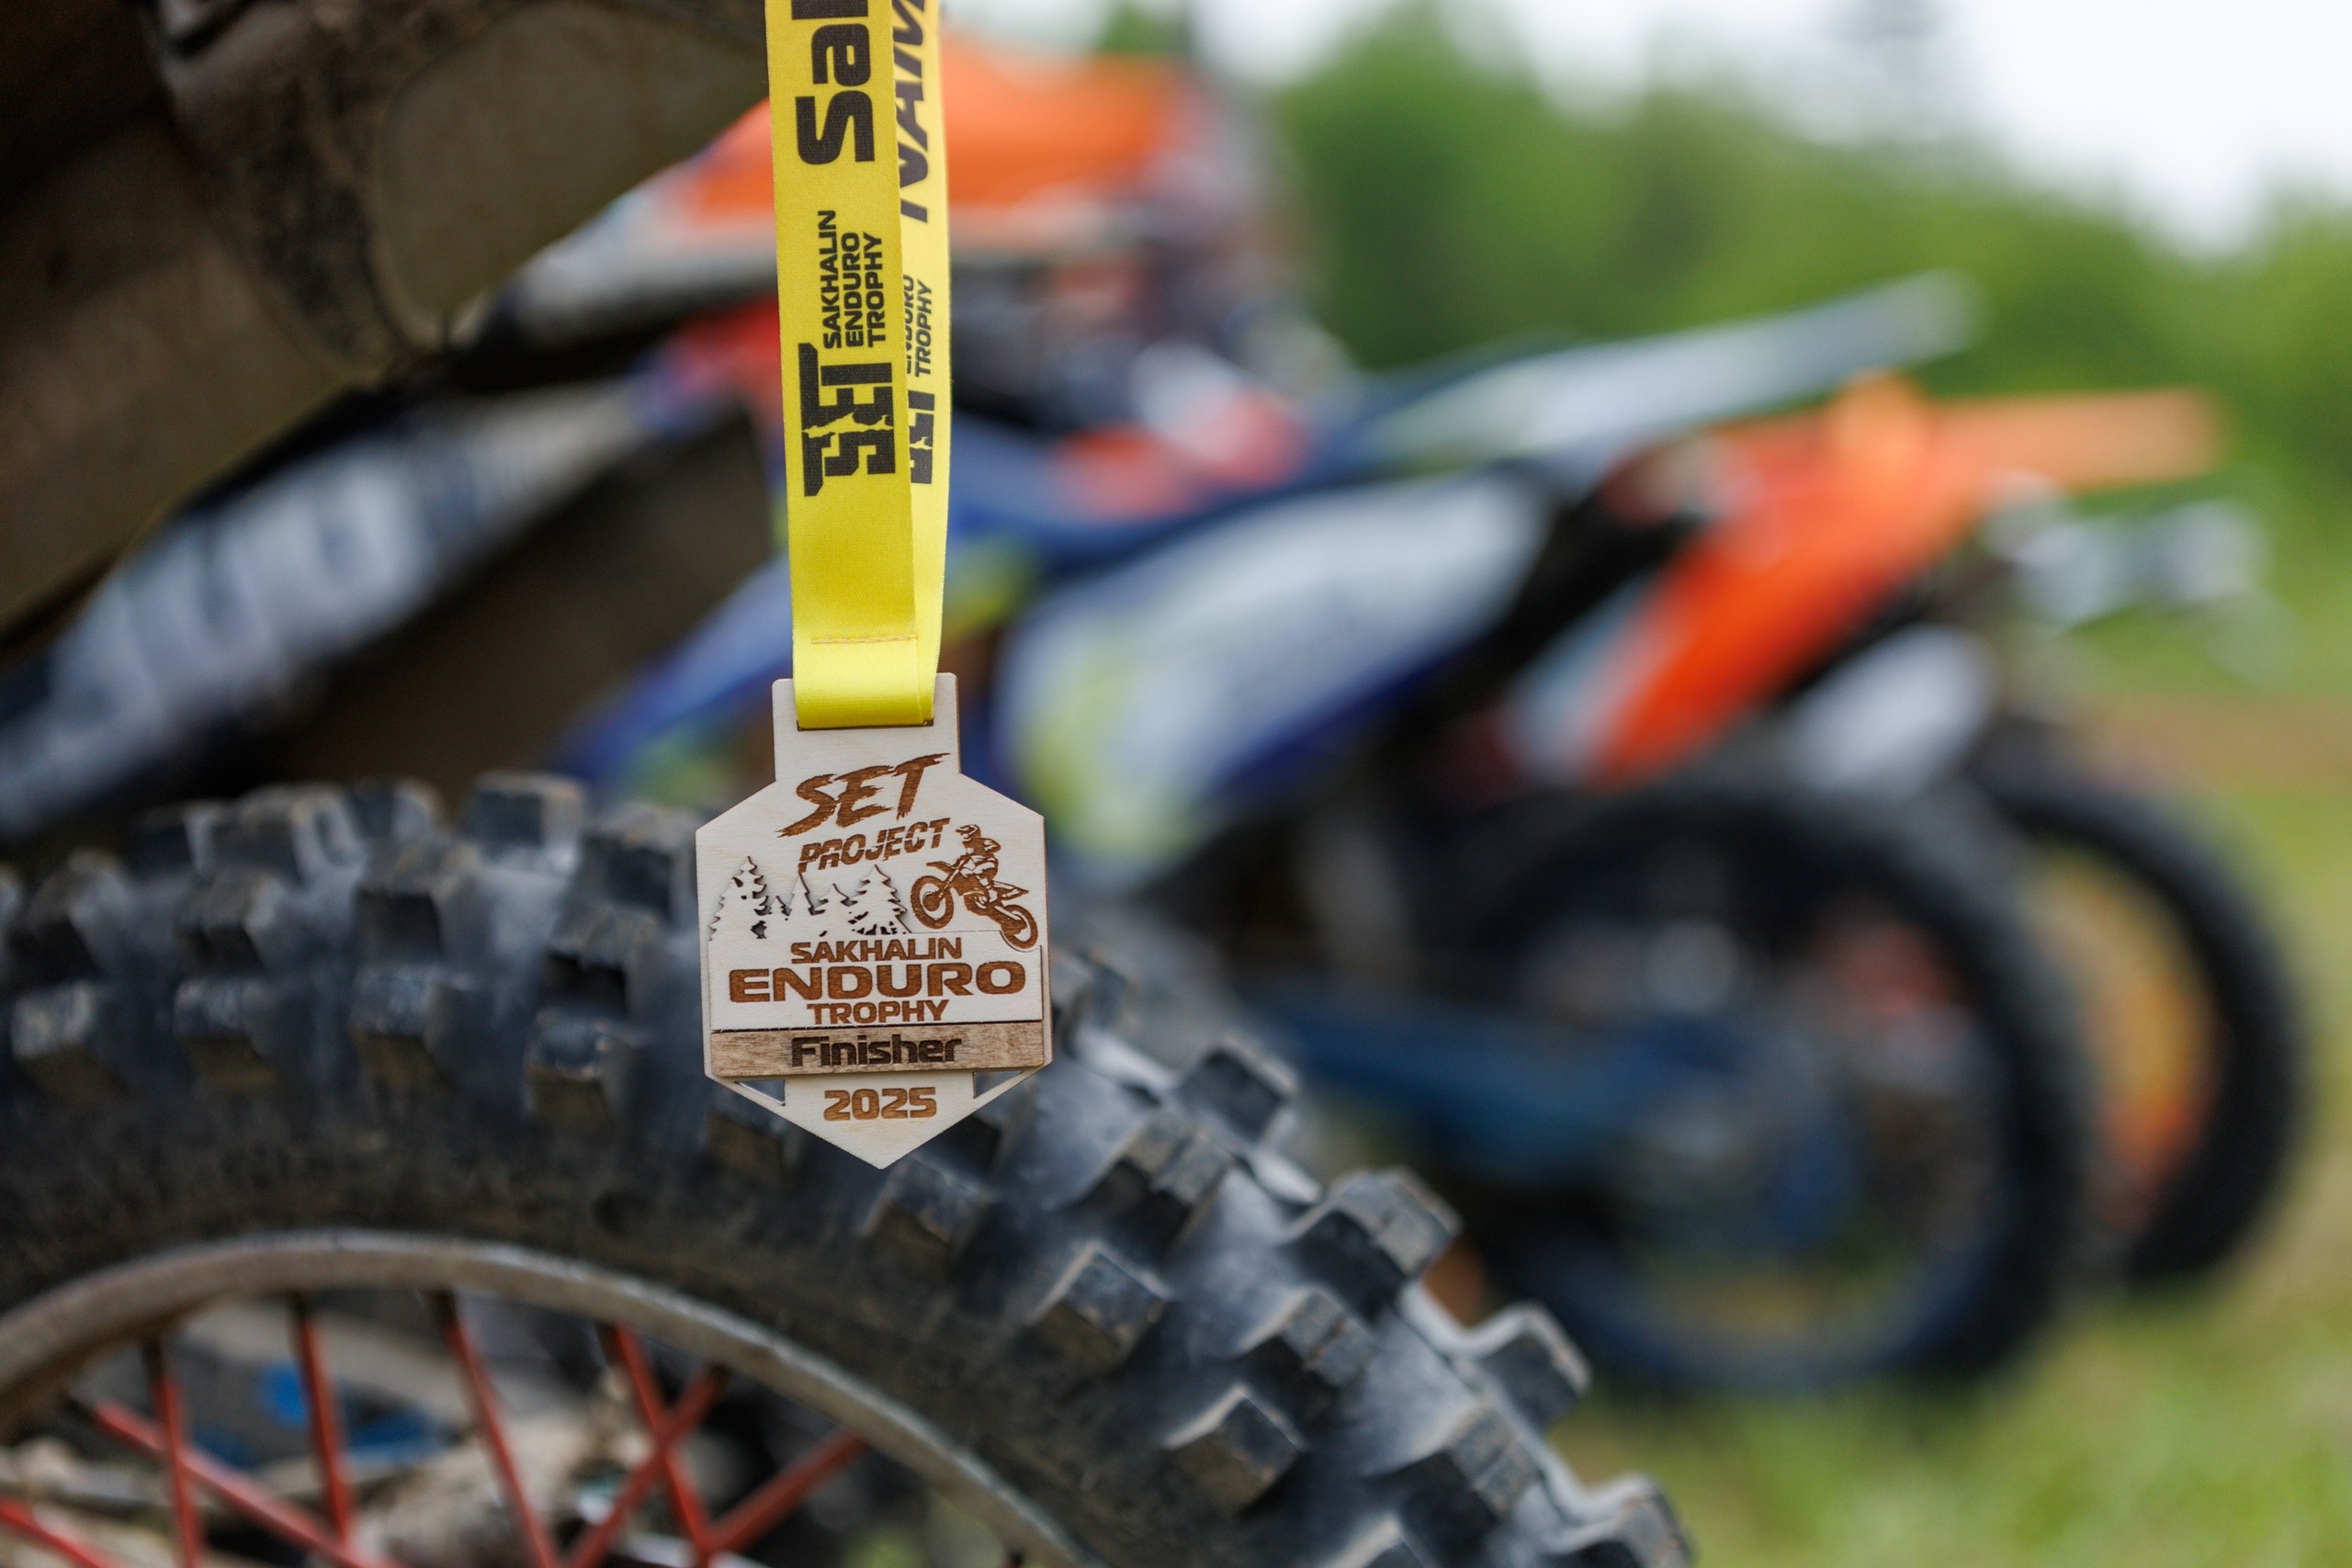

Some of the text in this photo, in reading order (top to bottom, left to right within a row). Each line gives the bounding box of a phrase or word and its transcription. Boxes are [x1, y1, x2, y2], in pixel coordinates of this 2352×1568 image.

[791, 0, 875, 164] Sa
[818, 209, 842, 349] SAKHALIN
[842, 231, 864, 347] ENDURO
[863, 231, 885, 348] TROPHY
[914, 279, 933, 378] TROPHY
[776, 752, 951, 838] SET
[797, 818, 951, 873] PROJECT
[729, 960, 1026, 1003] ENDURO
[790, 937, 963, 964] SAKHALIN
[806, 998, 950, 1025] TROPHY
[791, 1033, 963, 1067] Finisher
[823, 1087, 937, 1122] 2025
